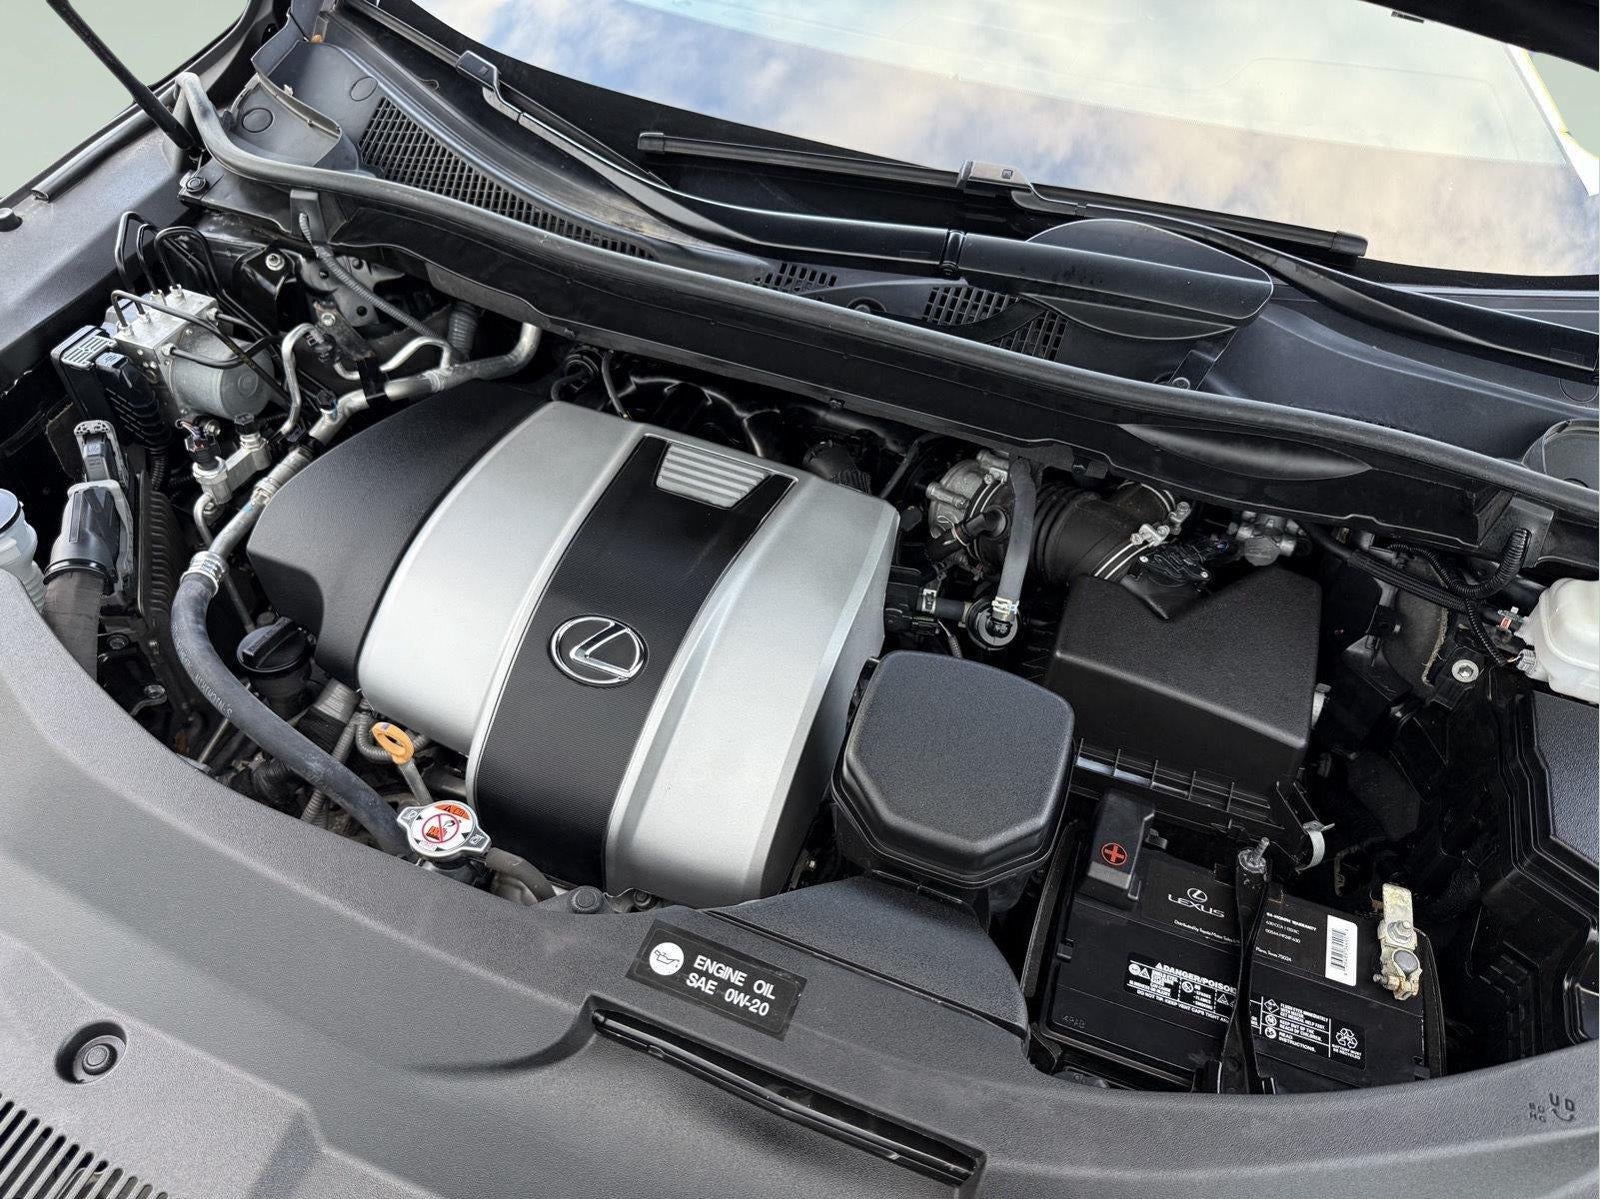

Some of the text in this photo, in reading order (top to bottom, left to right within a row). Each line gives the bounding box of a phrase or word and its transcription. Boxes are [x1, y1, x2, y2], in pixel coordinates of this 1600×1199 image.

[1168, 894, 1225, 918] LEXUS
[1292, 920, 1316, 931] WARRANTY
[693, 954, 776, 999] ENGINE OIL
[685, 972, 770, 1017] SAE 0W-20
